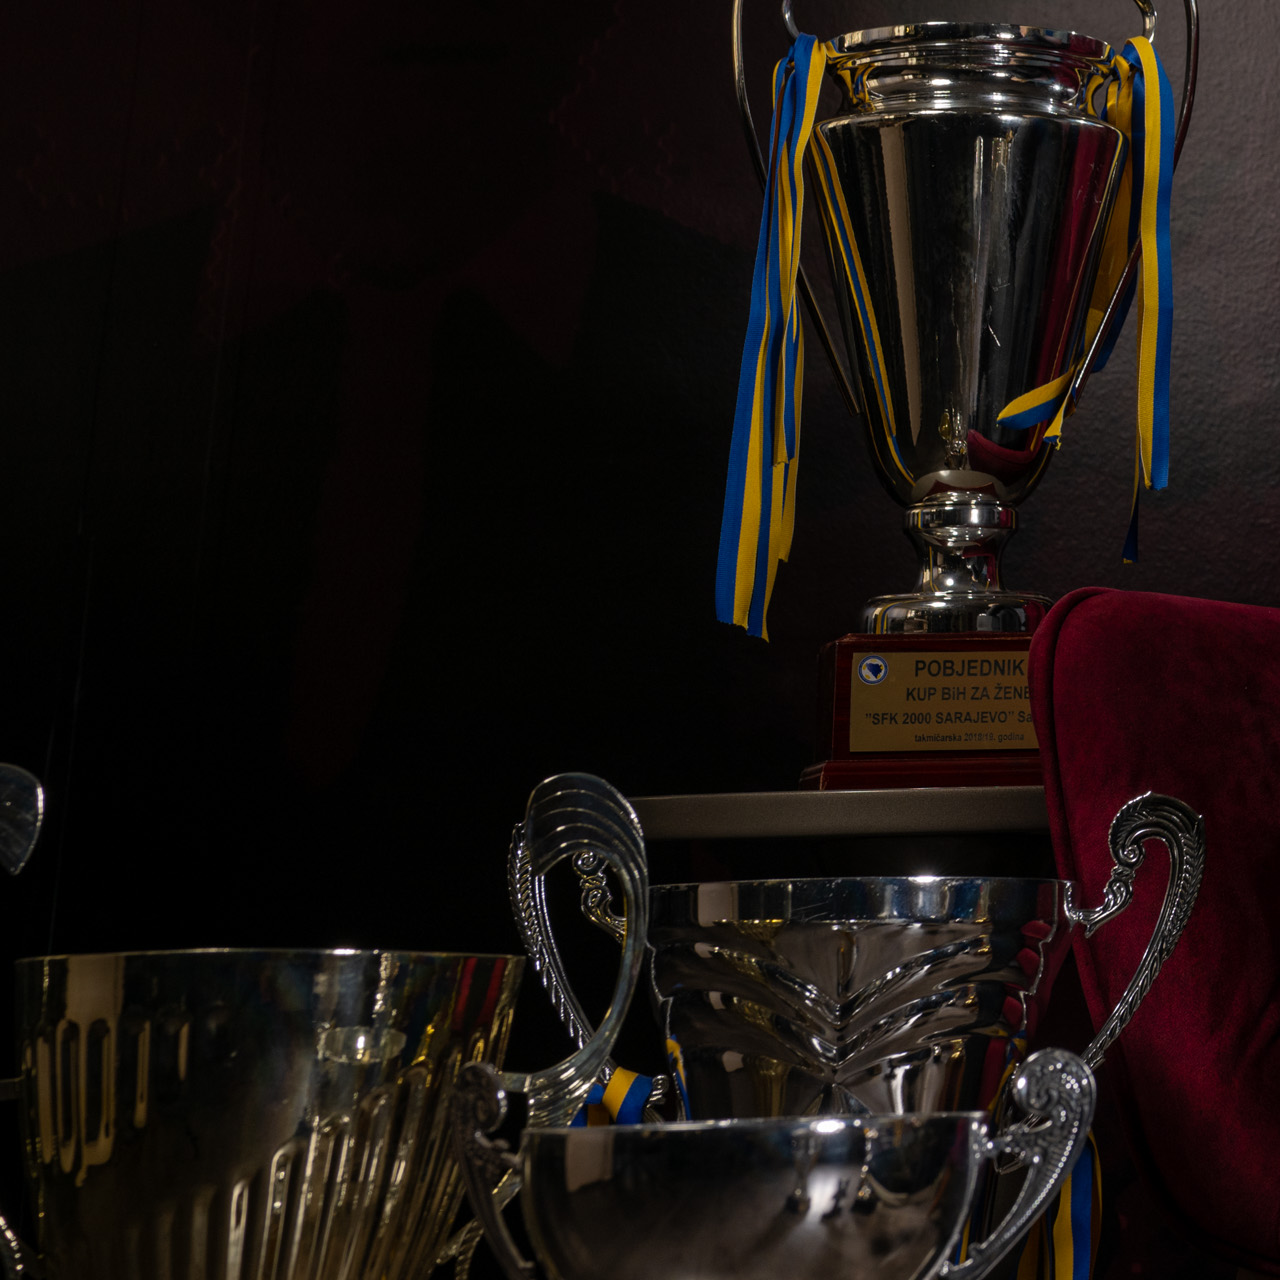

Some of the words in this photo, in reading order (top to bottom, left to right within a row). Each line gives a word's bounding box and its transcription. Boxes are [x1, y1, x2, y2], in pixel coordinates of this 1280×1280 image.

[915, 659, 1025, 678] POBJEDNIK
[905, 686, 937, 702] KUP
[941, 686, 967, 702] BiH
[969, 686, 991, 701] ZA
[901, 711, 932, 725] 2000
